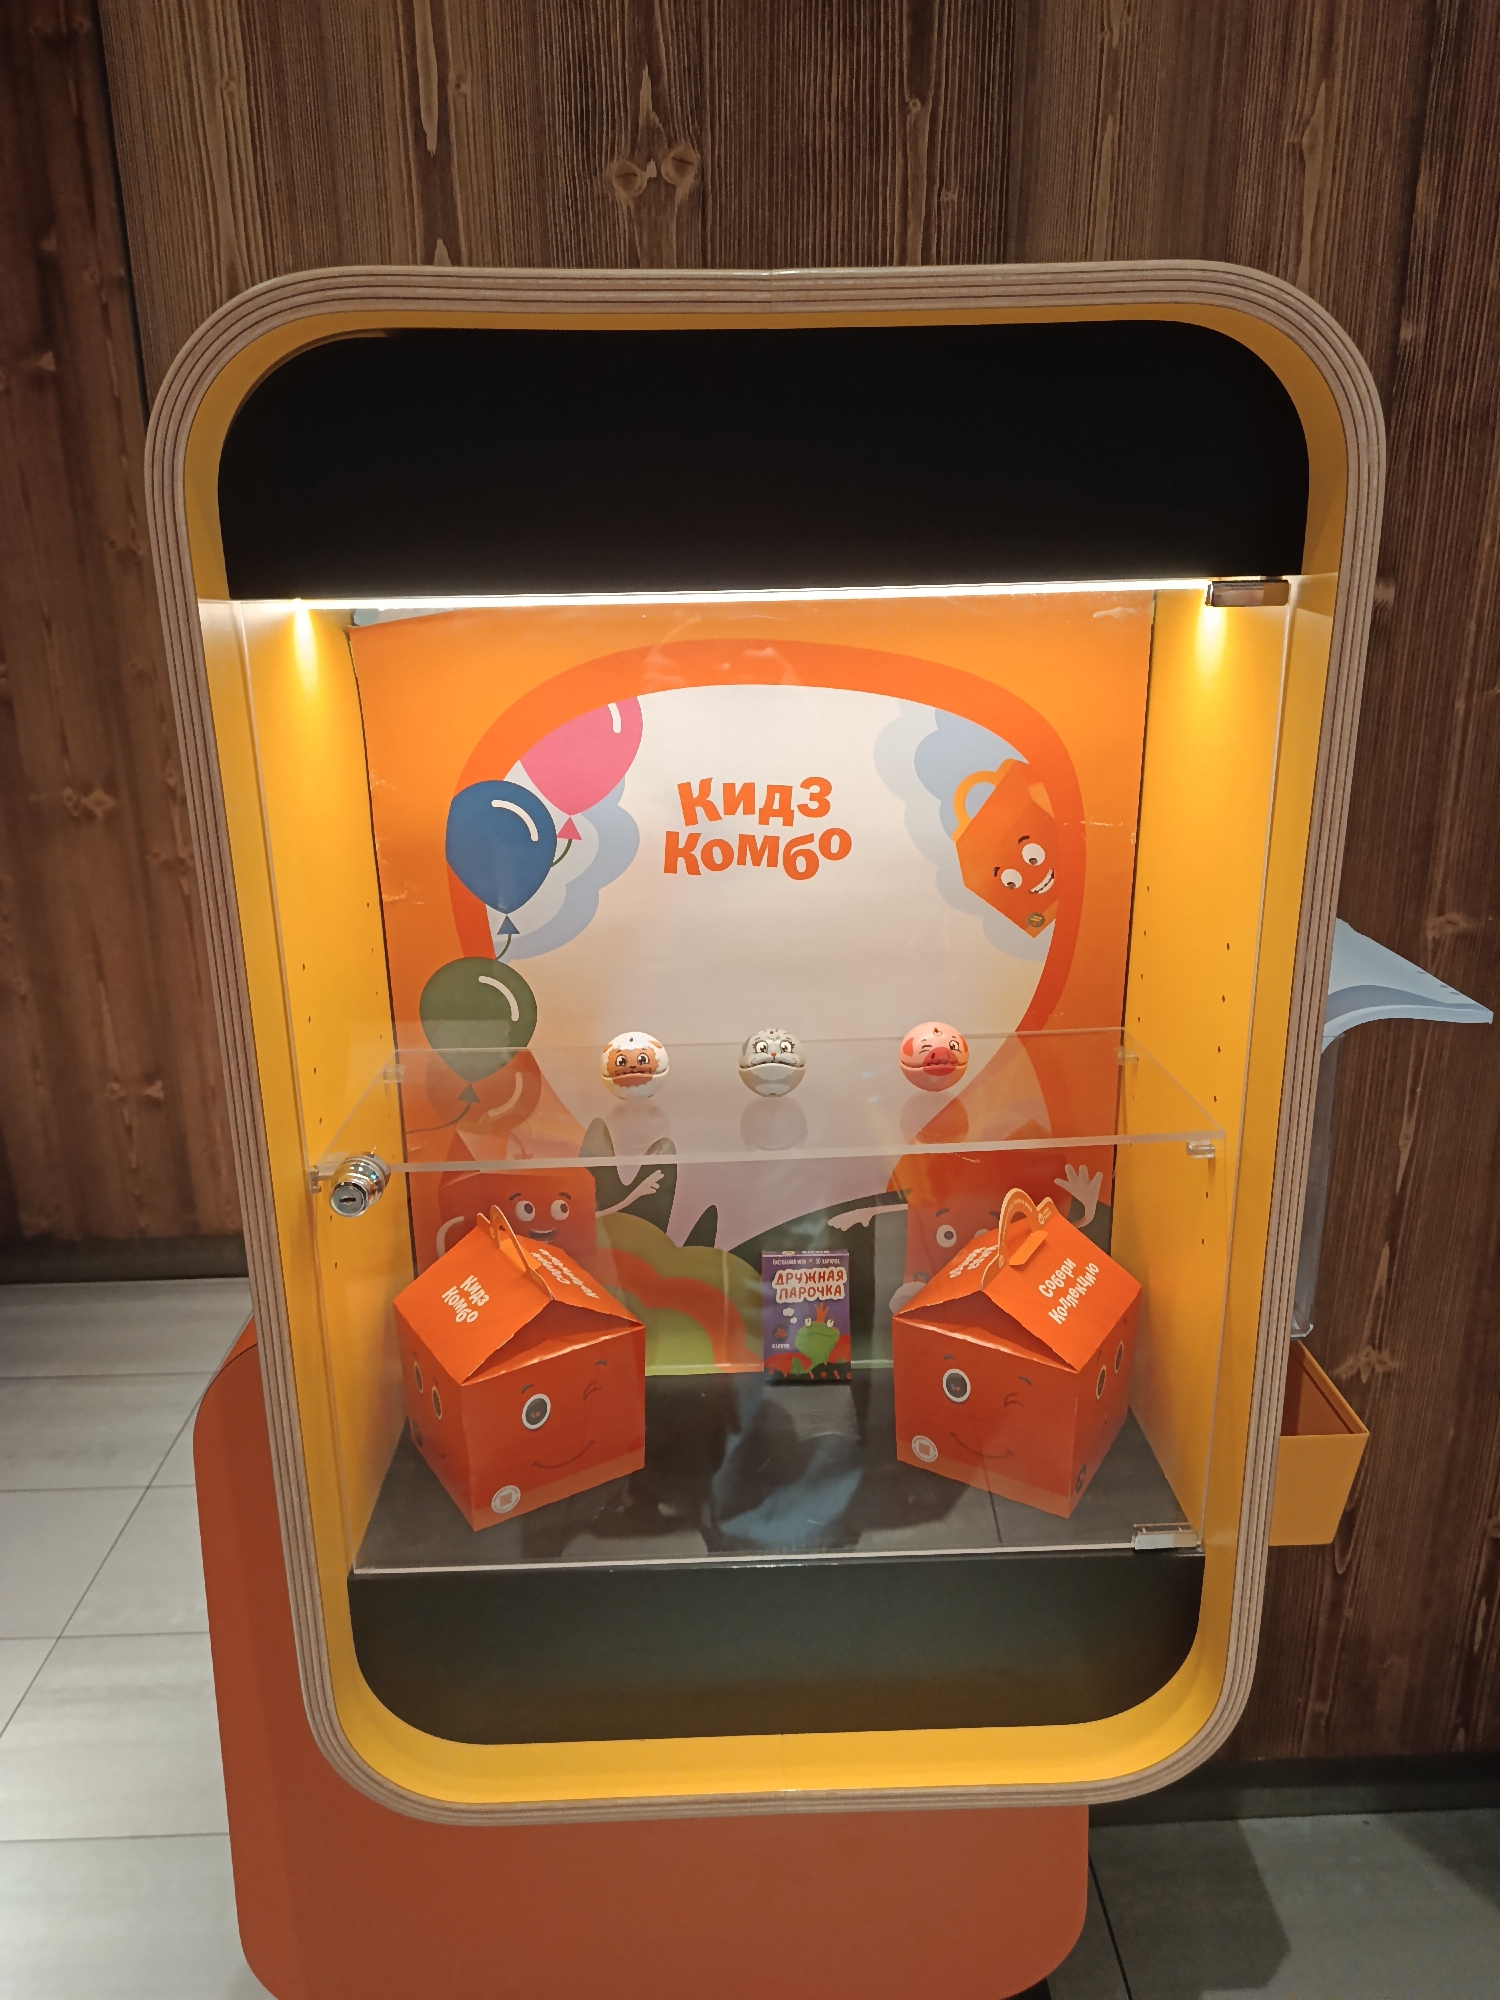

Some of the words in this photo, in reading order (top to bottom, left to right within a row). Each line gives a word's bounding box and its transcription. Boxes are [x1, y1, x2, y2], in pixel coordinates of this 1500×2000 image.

[663, 827, 852, 881] Комбо
[775, 1269, 844, 1285] ДРУЖНАЯ
[779, 1284, 842, 1300] ПАРОЧКА
[1038, 1257, 1077, 1298] Собери
[1048, 1262, 1100, 1325] Коллекцию
[441, 1285, 479, 1323] Комбо
